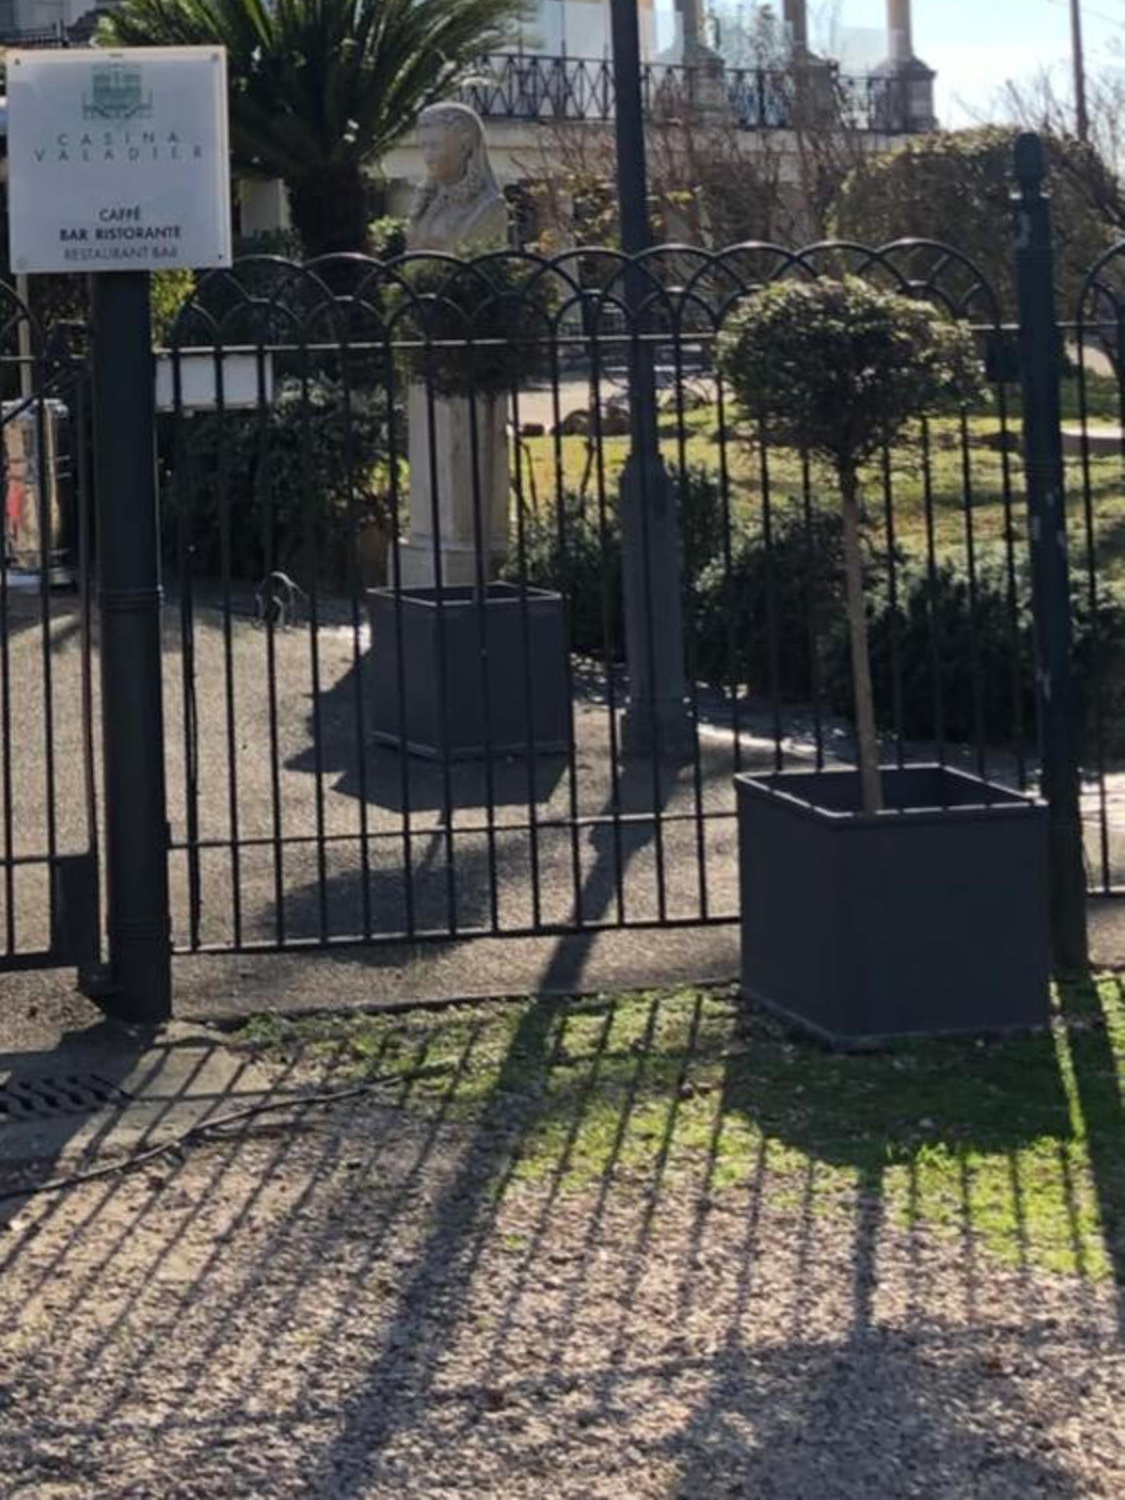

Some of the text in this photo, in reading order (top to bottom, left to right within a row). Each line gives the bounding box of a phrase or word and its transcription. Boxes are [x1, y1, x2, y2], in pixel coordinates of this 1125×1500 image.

[58, 131, 179, 146] CASINA
[34, 145, 203, 163] VALADIER
[98, 205, 141, 222] CAFFÉ
[59, 225, 182, 241] BAR RISTORANTE
[63, 245, 178, 261] RESTAURANT BAR
